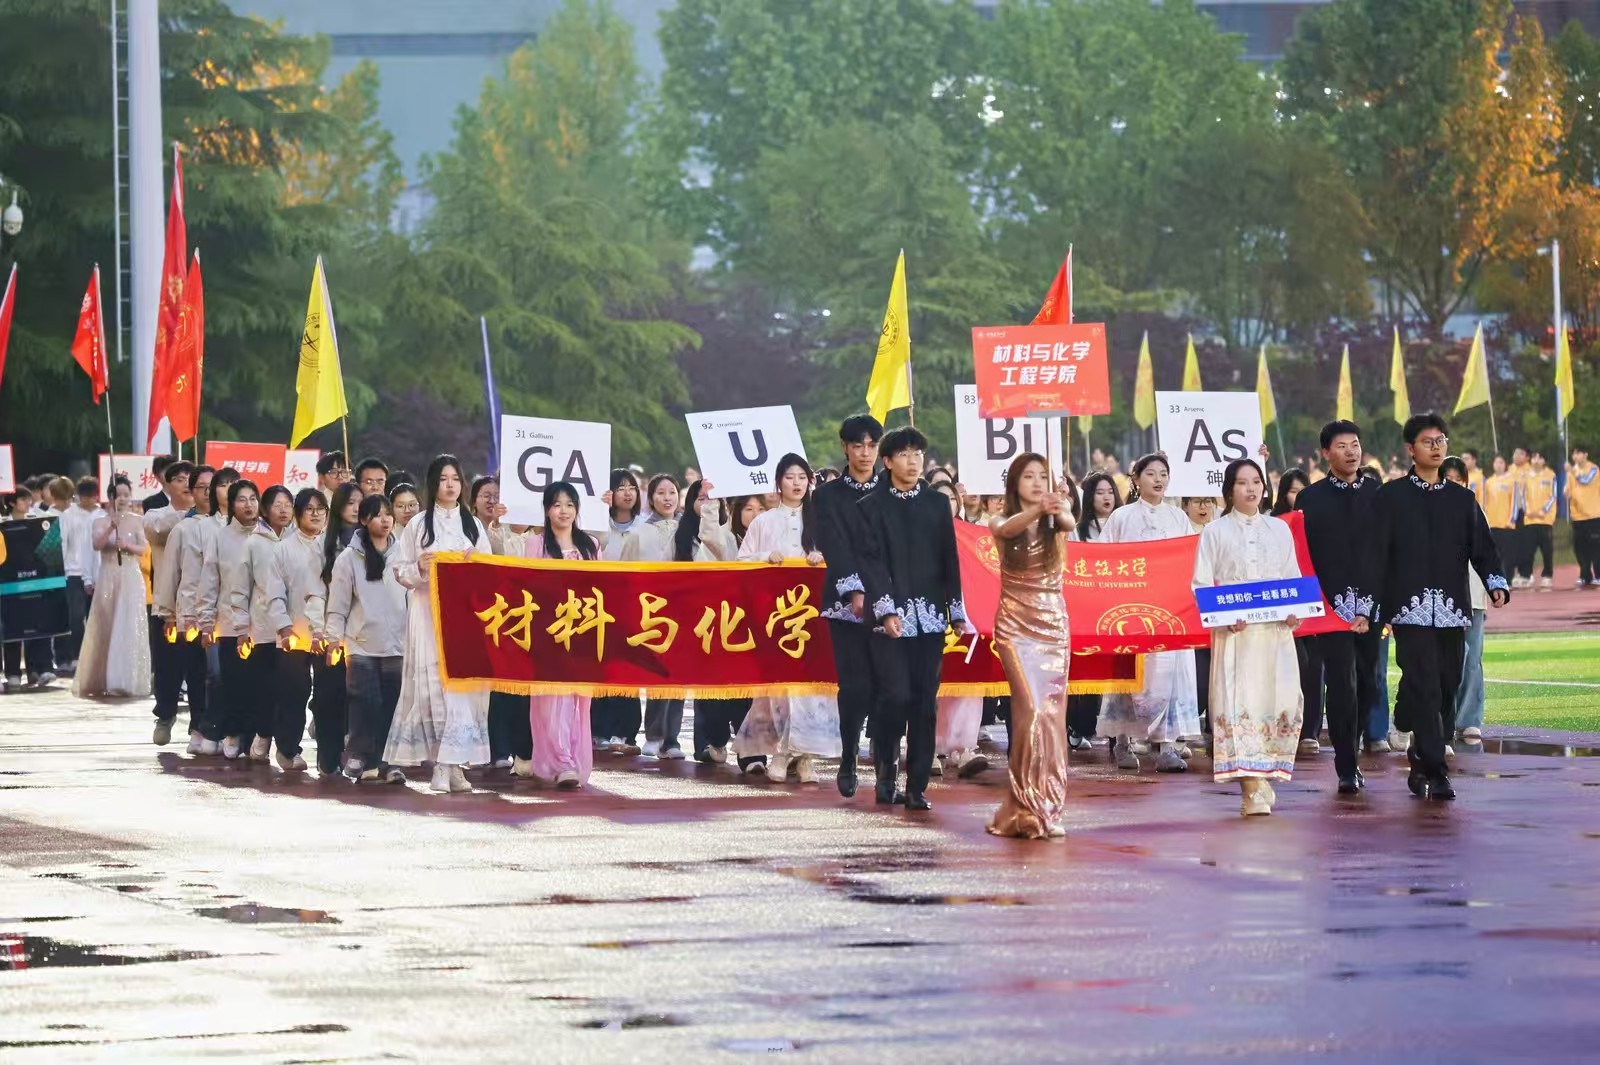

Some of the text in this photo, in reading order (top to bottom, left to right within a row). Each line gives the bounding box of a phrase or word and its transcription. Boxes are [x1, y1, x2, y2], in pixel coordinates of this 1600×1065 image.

[992, 341, 1090, 363] 材料与化学
[1000, 365, 1077, 386] 工程学院
[964, 395, 976, 404] 83
[1169, 405, 1180, 414] 33
[515, 429, 554, 440] 31 Gallium
[702, 422, 714, 430] 92
[728, 429, 769, 467] U
[1184, 418, 1248, 463] As
[517, 445, 596, 497] GA
[749, 470, 769, 486] 铀
[1062, 557, 1147, 577] 建筑大学
[1099, 581, 1148, 589] UNIVERSITY
